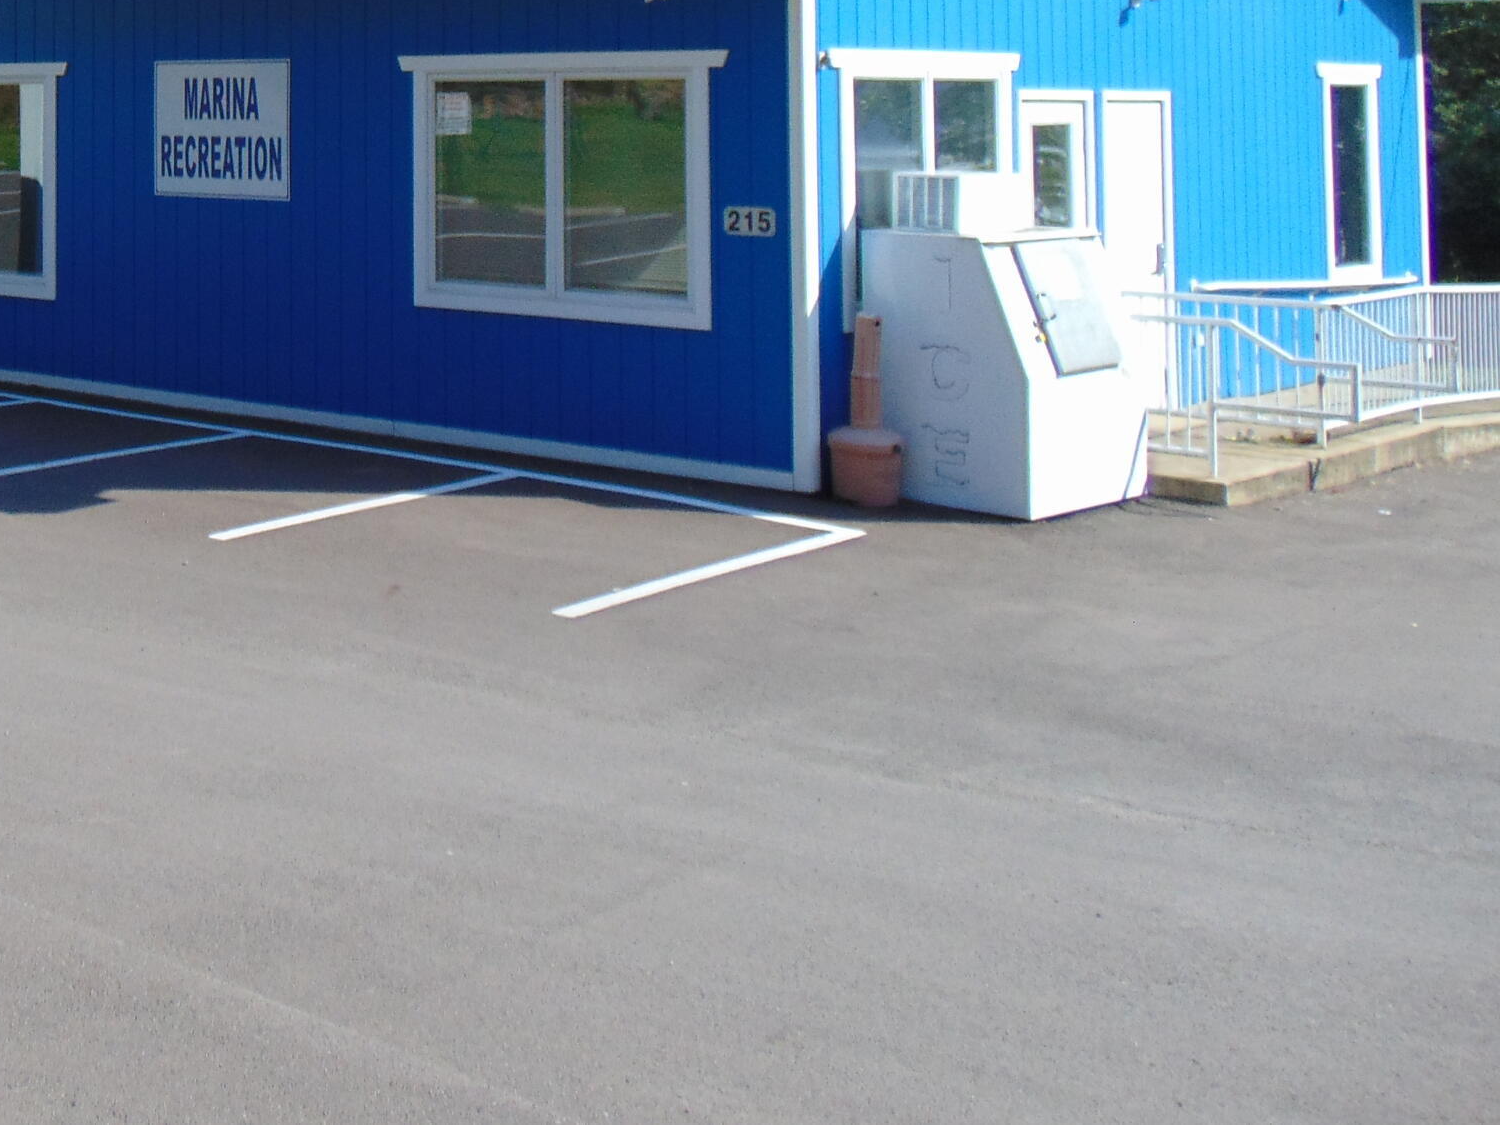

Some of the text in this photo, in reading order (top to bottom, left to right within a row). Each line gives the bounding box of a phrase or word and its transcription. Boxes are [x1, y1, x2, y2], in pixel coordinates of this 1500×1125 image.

[184, 77, 259, 120] MARINA
[161, 135, 282, 181] RECREATION
[728, 210, 771, 233] 215
